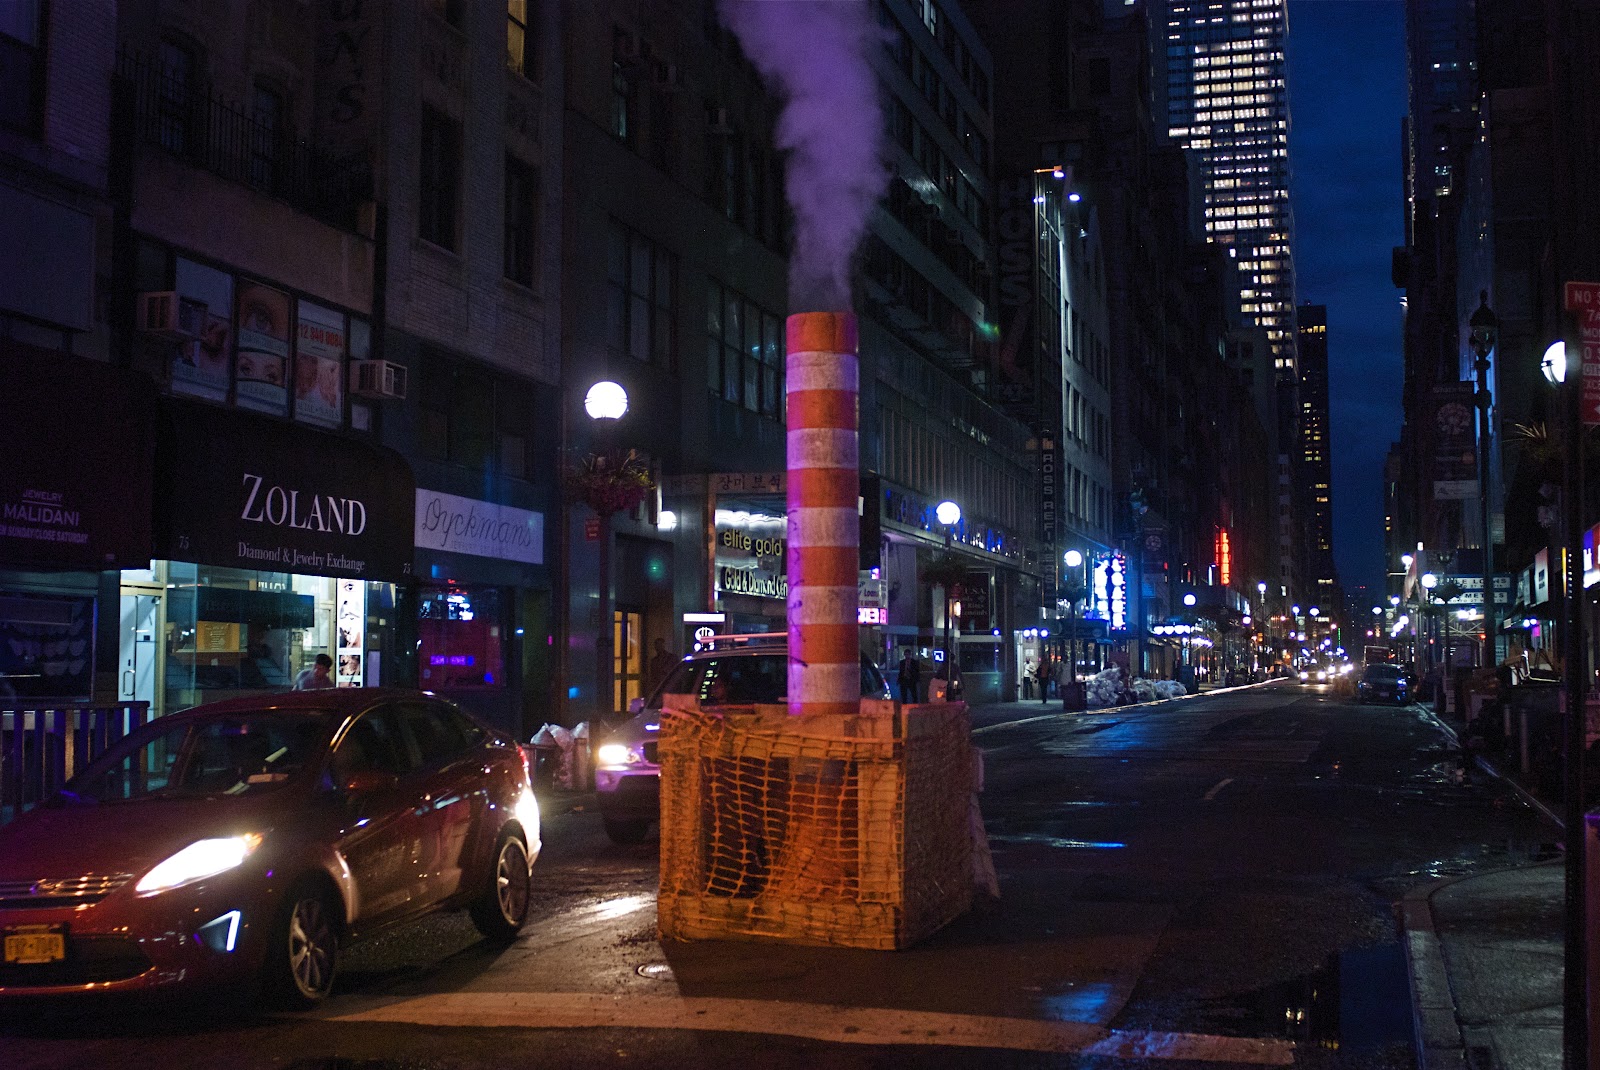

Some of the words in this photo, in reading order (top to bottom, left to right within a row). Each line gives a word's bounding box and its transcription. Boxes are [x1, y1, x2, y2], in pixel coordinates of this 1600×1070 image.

[1574, 290, 1592, 304] NO
[1042, 453, 1054, 495] ROSS
[22, 489, 64, 501] JEWELRY
[241, 473, 367, 536] ZOLAND
[3, 502, 80, 526] MALIDANI
[422, 498, 531, 547] Dyckmans
[8, 526, 34, 538] SUNDAY
[35, 529, 56, 541] CLOSE
[57, 531, 89, 544] SATURDAY
[179, 535, 189, 550] 75
[723, 528, 752, 551] elite
[755, 537, 783, 558] gold
[1043, 501, 1056, 584] REFINERS
[238, 542, 281, 562] Diamond
[282, 548, 291, 563] &
[291, 549, 325, 570] Jewelry
[327, 553, 366, 573] Exchange
[402, 563, 411, 574] 75
[1222, 532, 1230, 585] LOANS
[725, 567, 741, 590] Gold
[742, 570, 748, 591] &
[749, 571, 775, 596] Diamond
